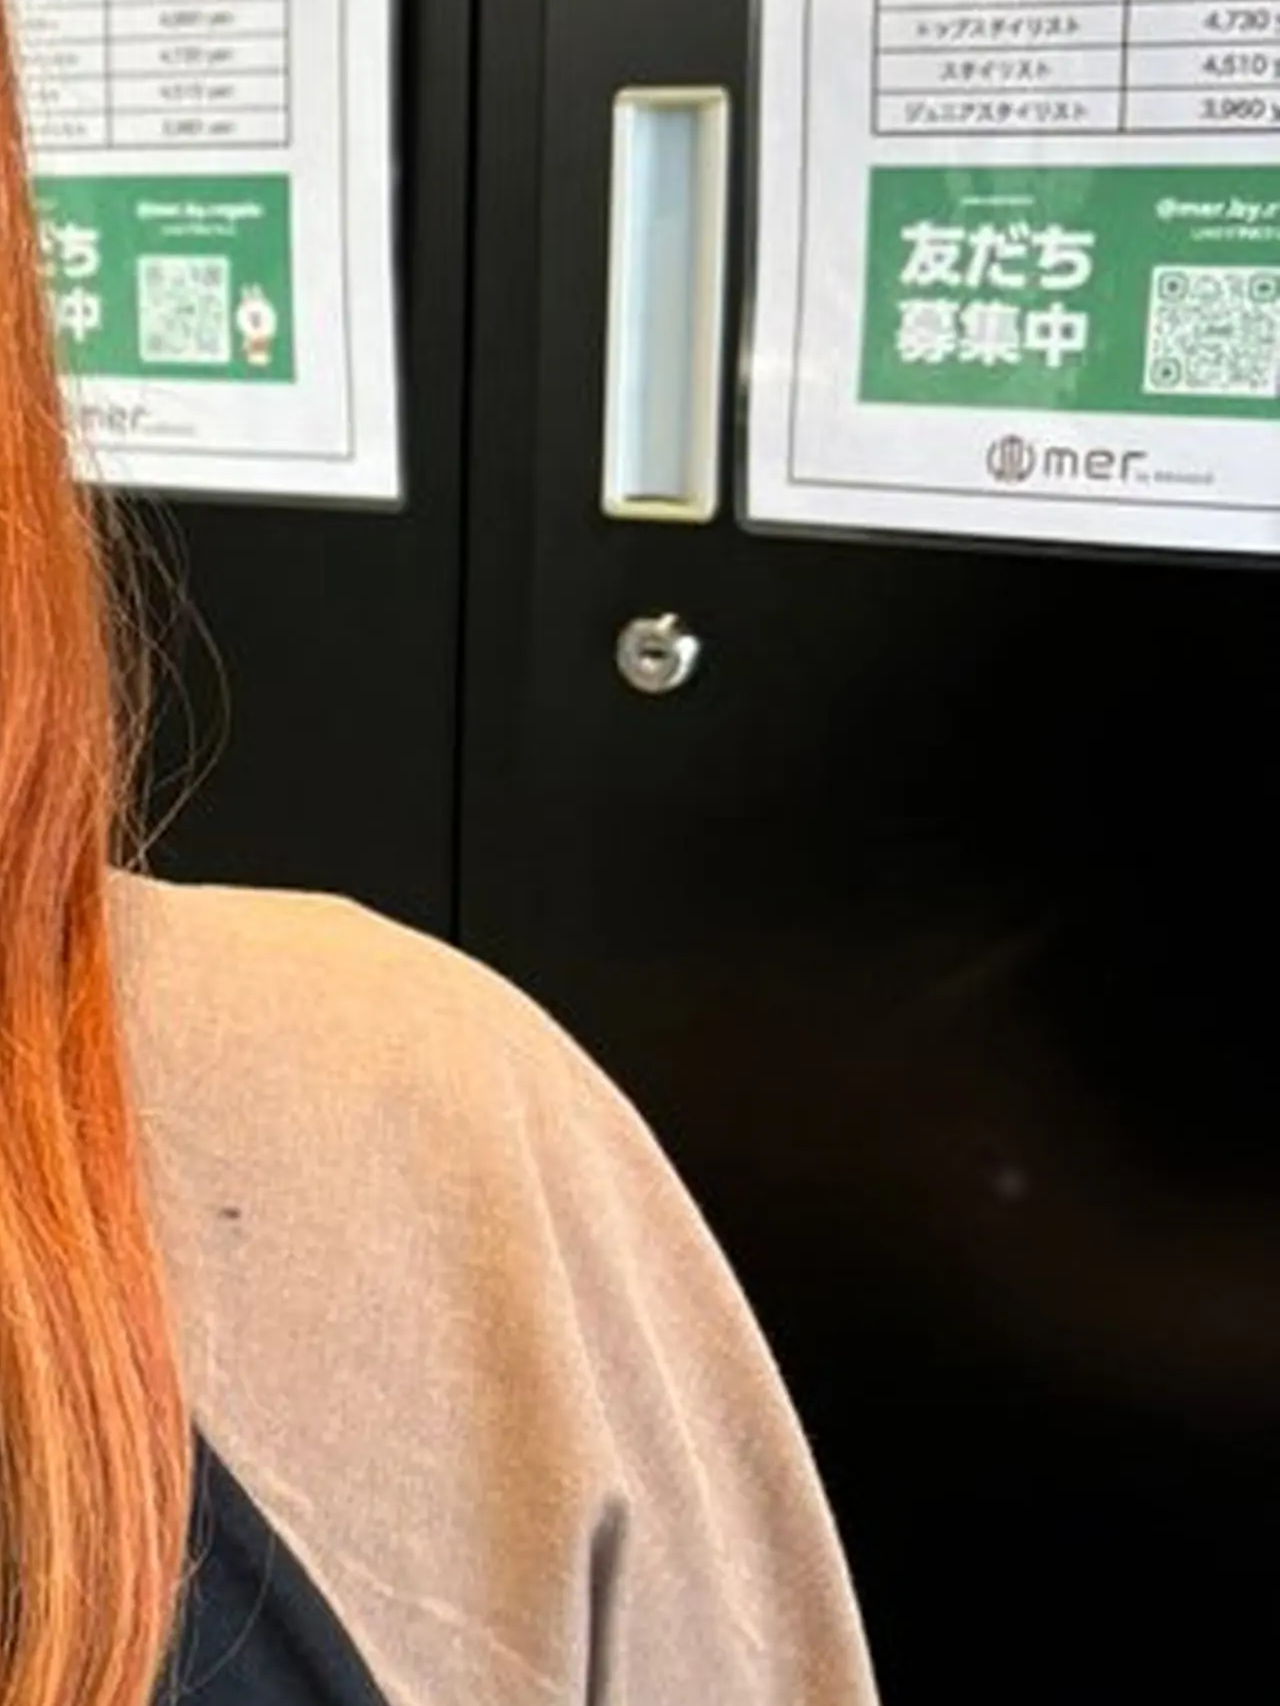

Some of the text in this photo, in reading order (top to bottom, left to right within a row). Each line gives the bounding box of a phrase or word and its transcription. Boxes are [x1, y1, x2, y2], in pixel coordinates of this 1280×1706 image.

[900, 220, 1097, 291] 友だち
[896, 297, 1089, 369] 募集中
[1043, 445, 1148, 482] mer
